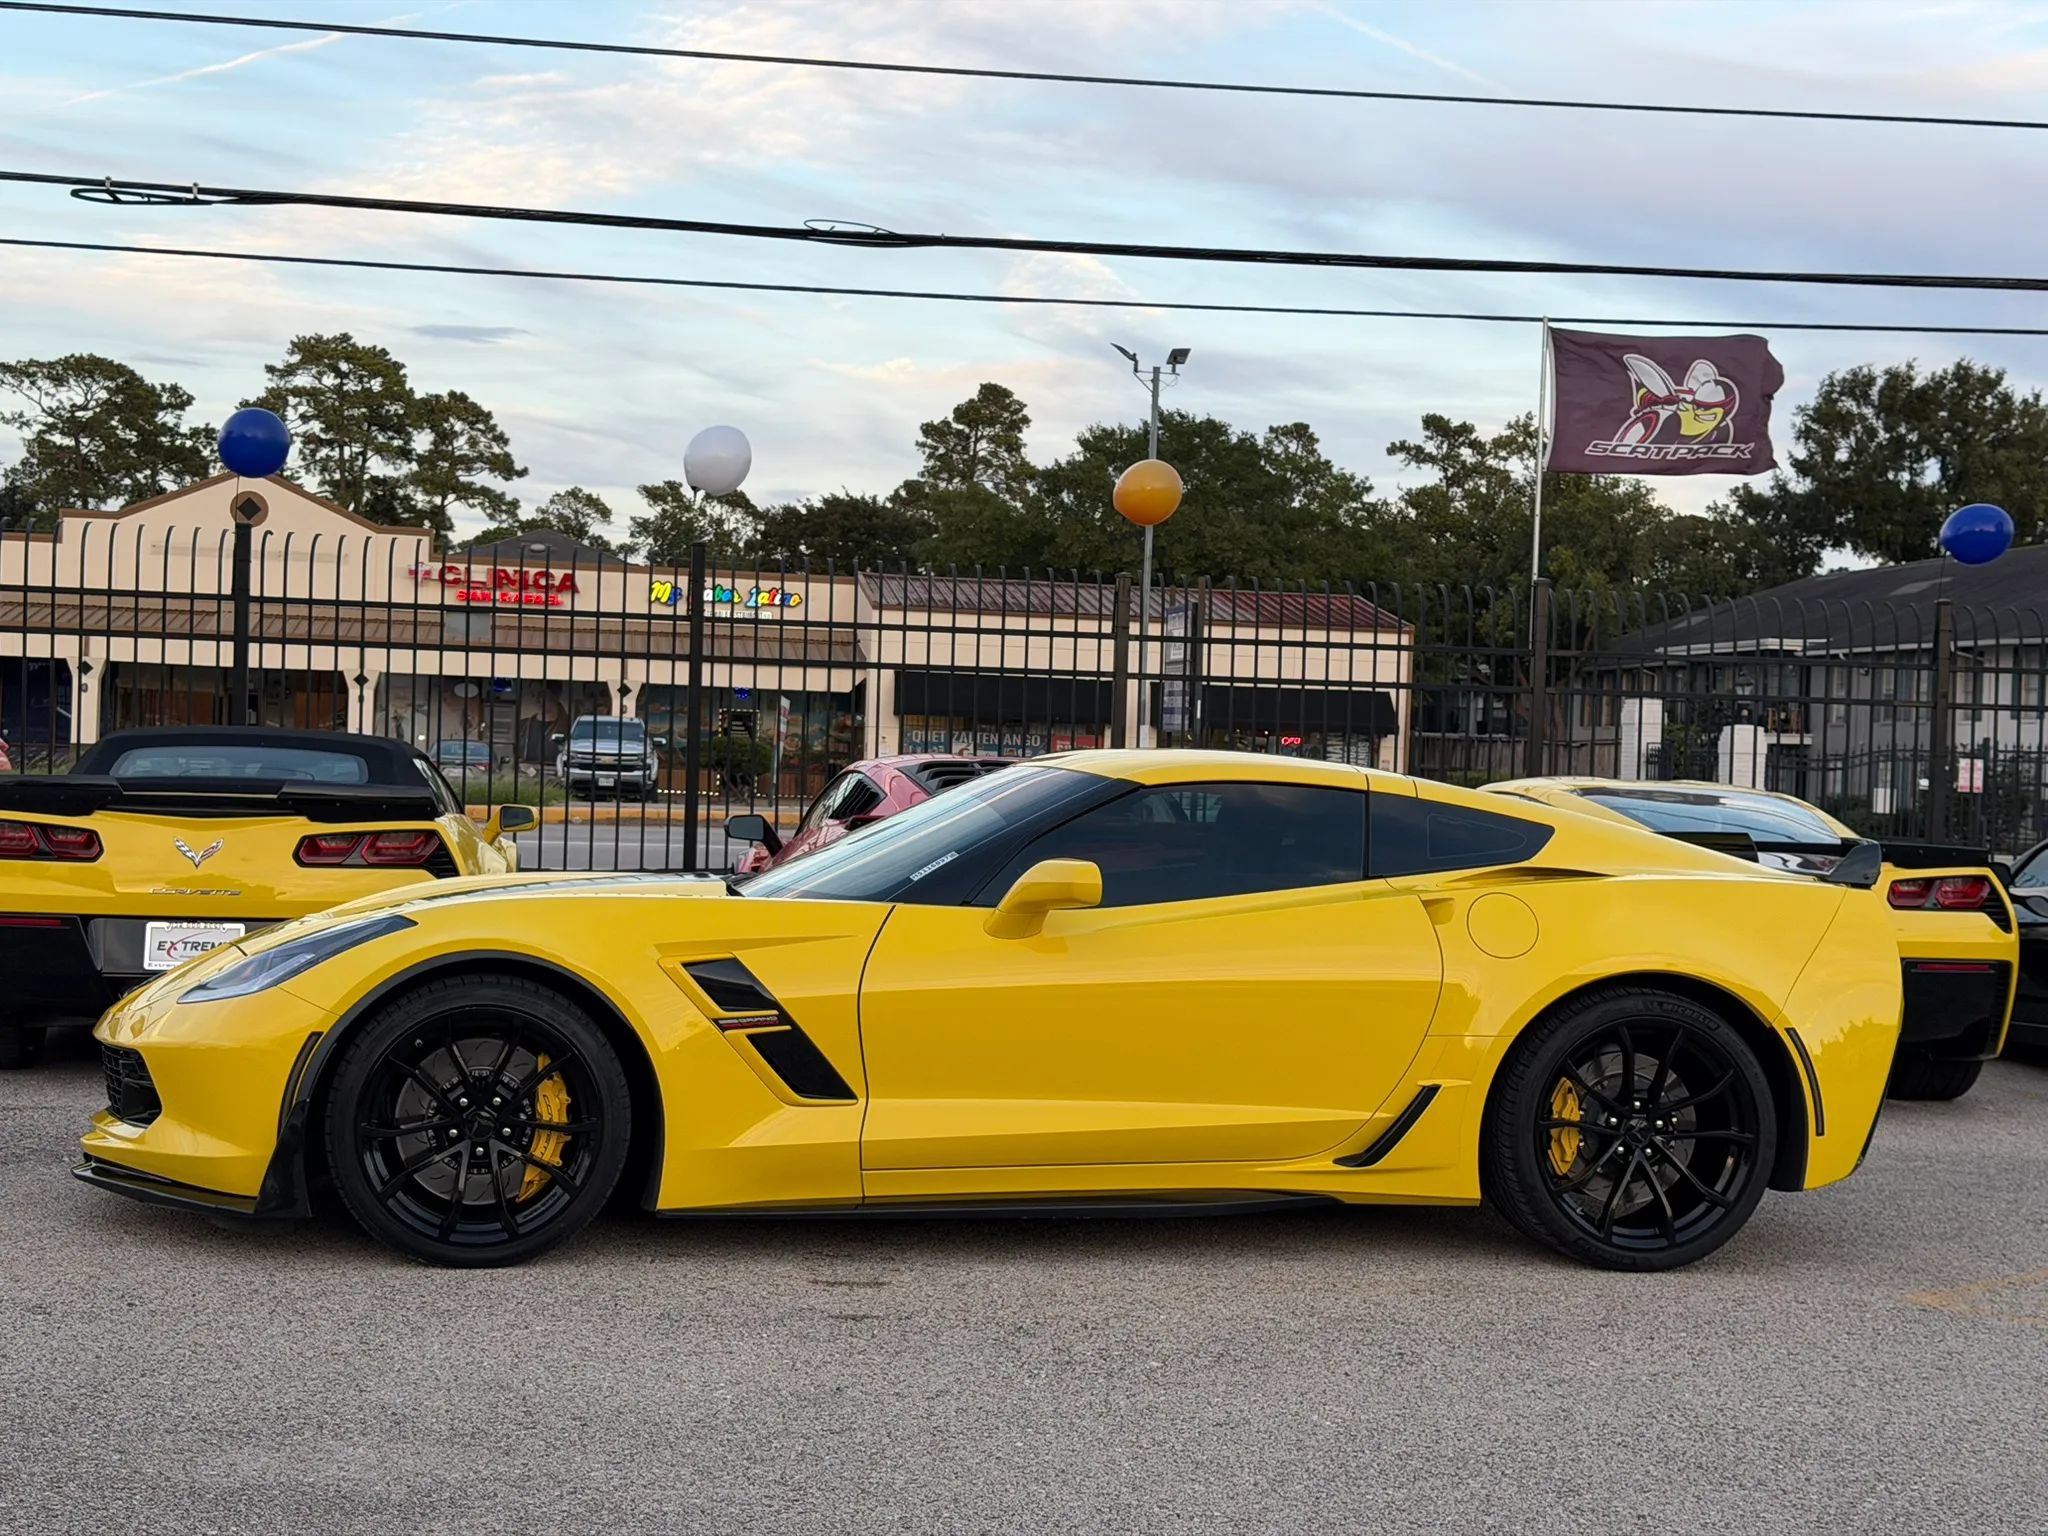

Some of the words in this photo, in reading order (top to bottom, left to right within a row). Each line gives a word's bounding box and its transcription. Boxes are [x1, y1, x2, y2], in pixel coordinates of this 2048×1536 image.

[438, 565, 580, 594] CLINICA
[456, 589, 491, 602] SAN
[499, 591, 564, 606] RAFAEL
